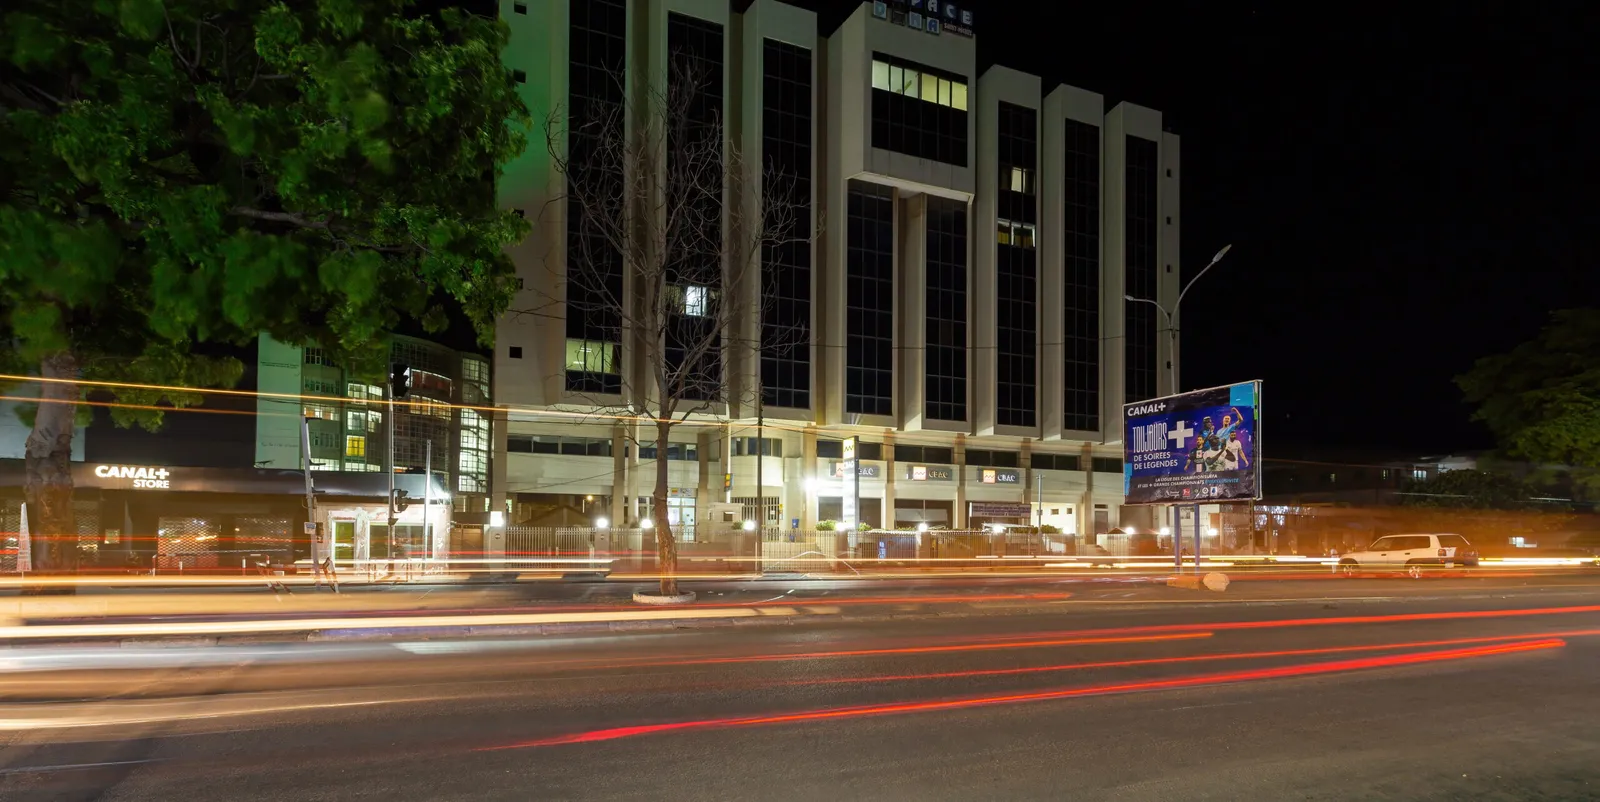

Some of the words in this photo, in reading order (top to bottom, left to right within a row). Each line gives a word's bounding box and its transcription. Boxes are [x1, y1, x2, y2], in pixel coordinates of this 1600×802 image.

[1128, 402, 1166, 416] CANAL+
[1133, 422, 1167, 453] TOUJOURS
[96, 466, 170, 479] CANAL+
[133, 479, 170, 489] STORE
